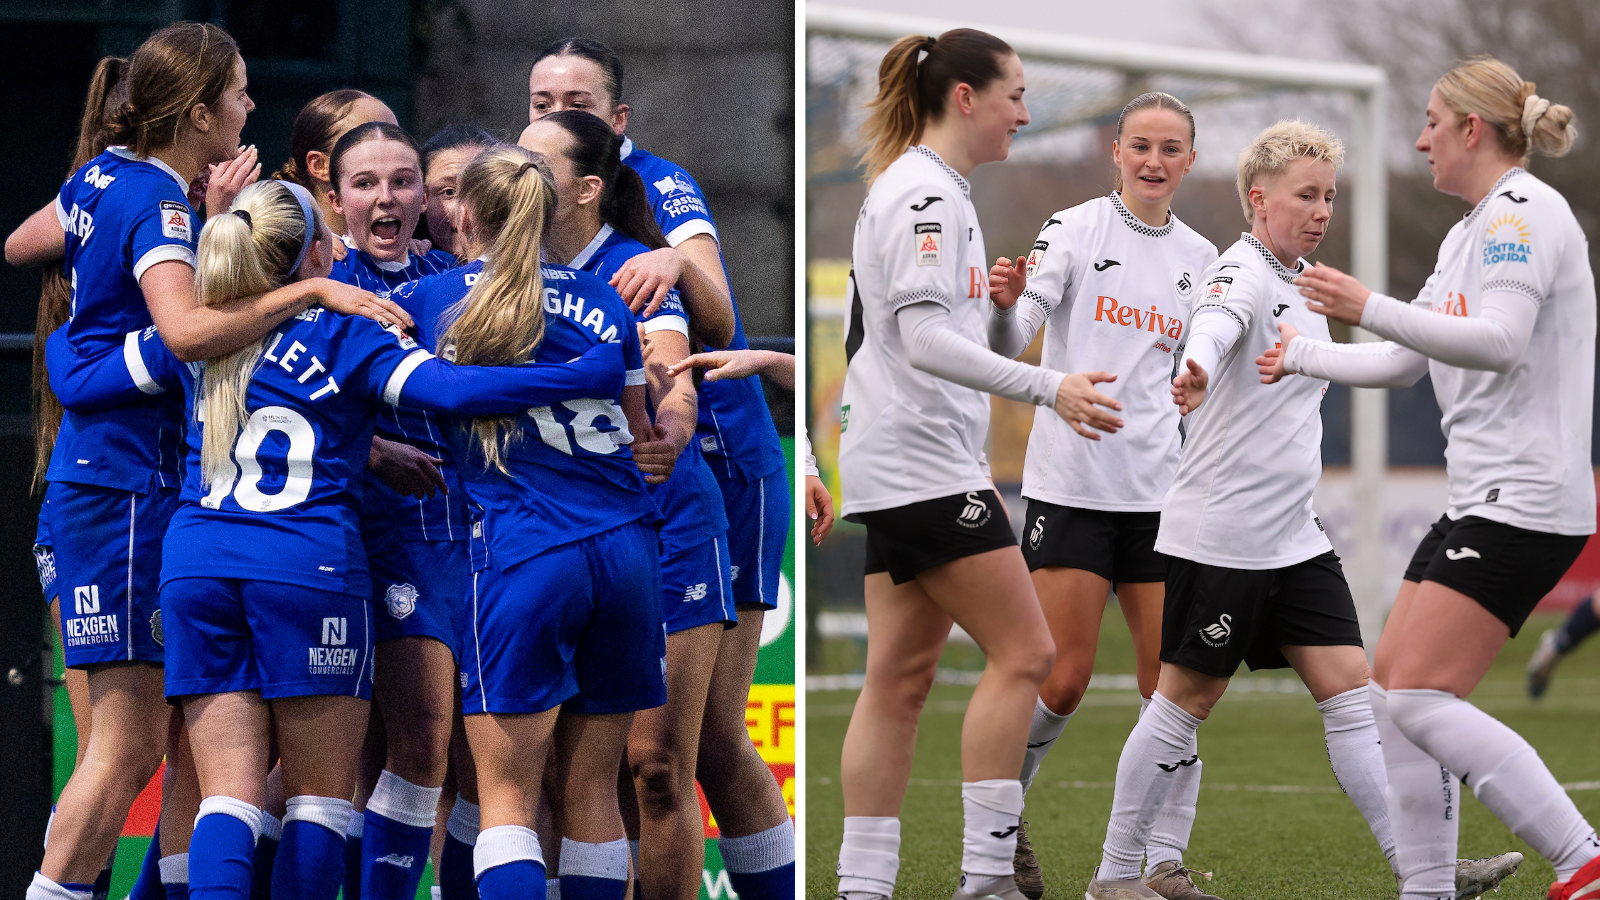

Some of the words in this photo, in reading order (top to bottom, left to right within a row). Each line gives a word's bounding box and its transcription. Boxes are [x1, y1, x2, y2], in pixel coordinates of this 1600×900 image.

[916, 224, 941, 233] genero
[1483, 243, 1532, 257] CENTRAL
[1483, 253, 1528, 268] FLORIDA
[1094, 295, 1183, 340] Reviva
[66, 614, 119, 638] NEXGEN
[67, 633, 120, 647] COMMERCIALS
[308, 647, 359, 667] NEXGEN
[308, 666, 354, 675] COMMERCIALS
